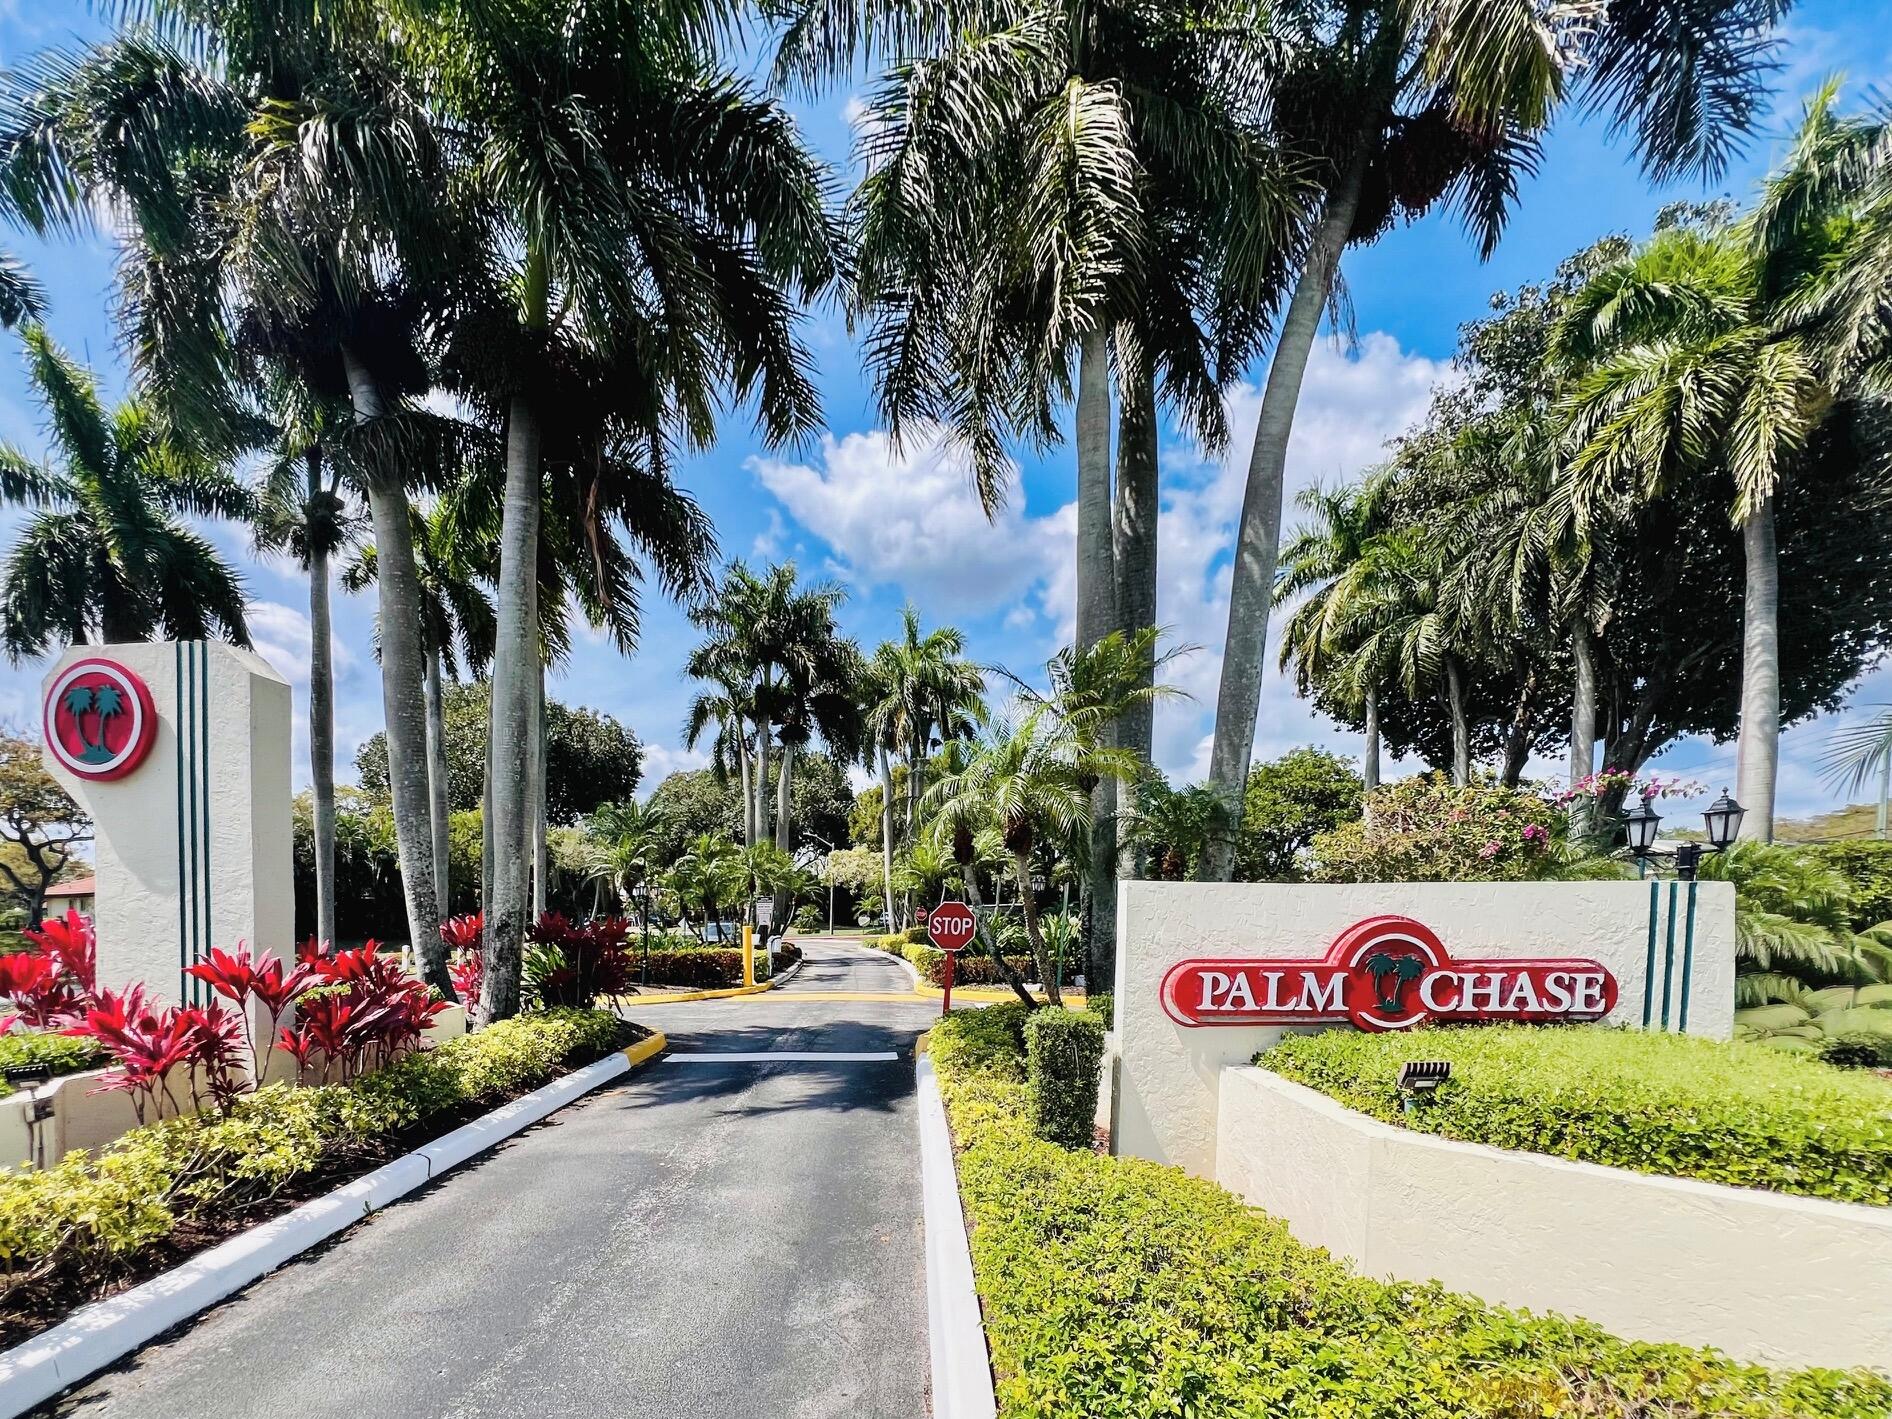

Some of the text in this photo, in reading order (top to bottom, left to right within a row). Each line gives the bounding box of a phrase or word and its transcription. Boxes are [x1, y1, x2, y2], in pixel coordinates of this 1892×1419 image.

[932, 917, 972, 935] STOP
[1196, 971, 1606, 1013] PALM CHASE
